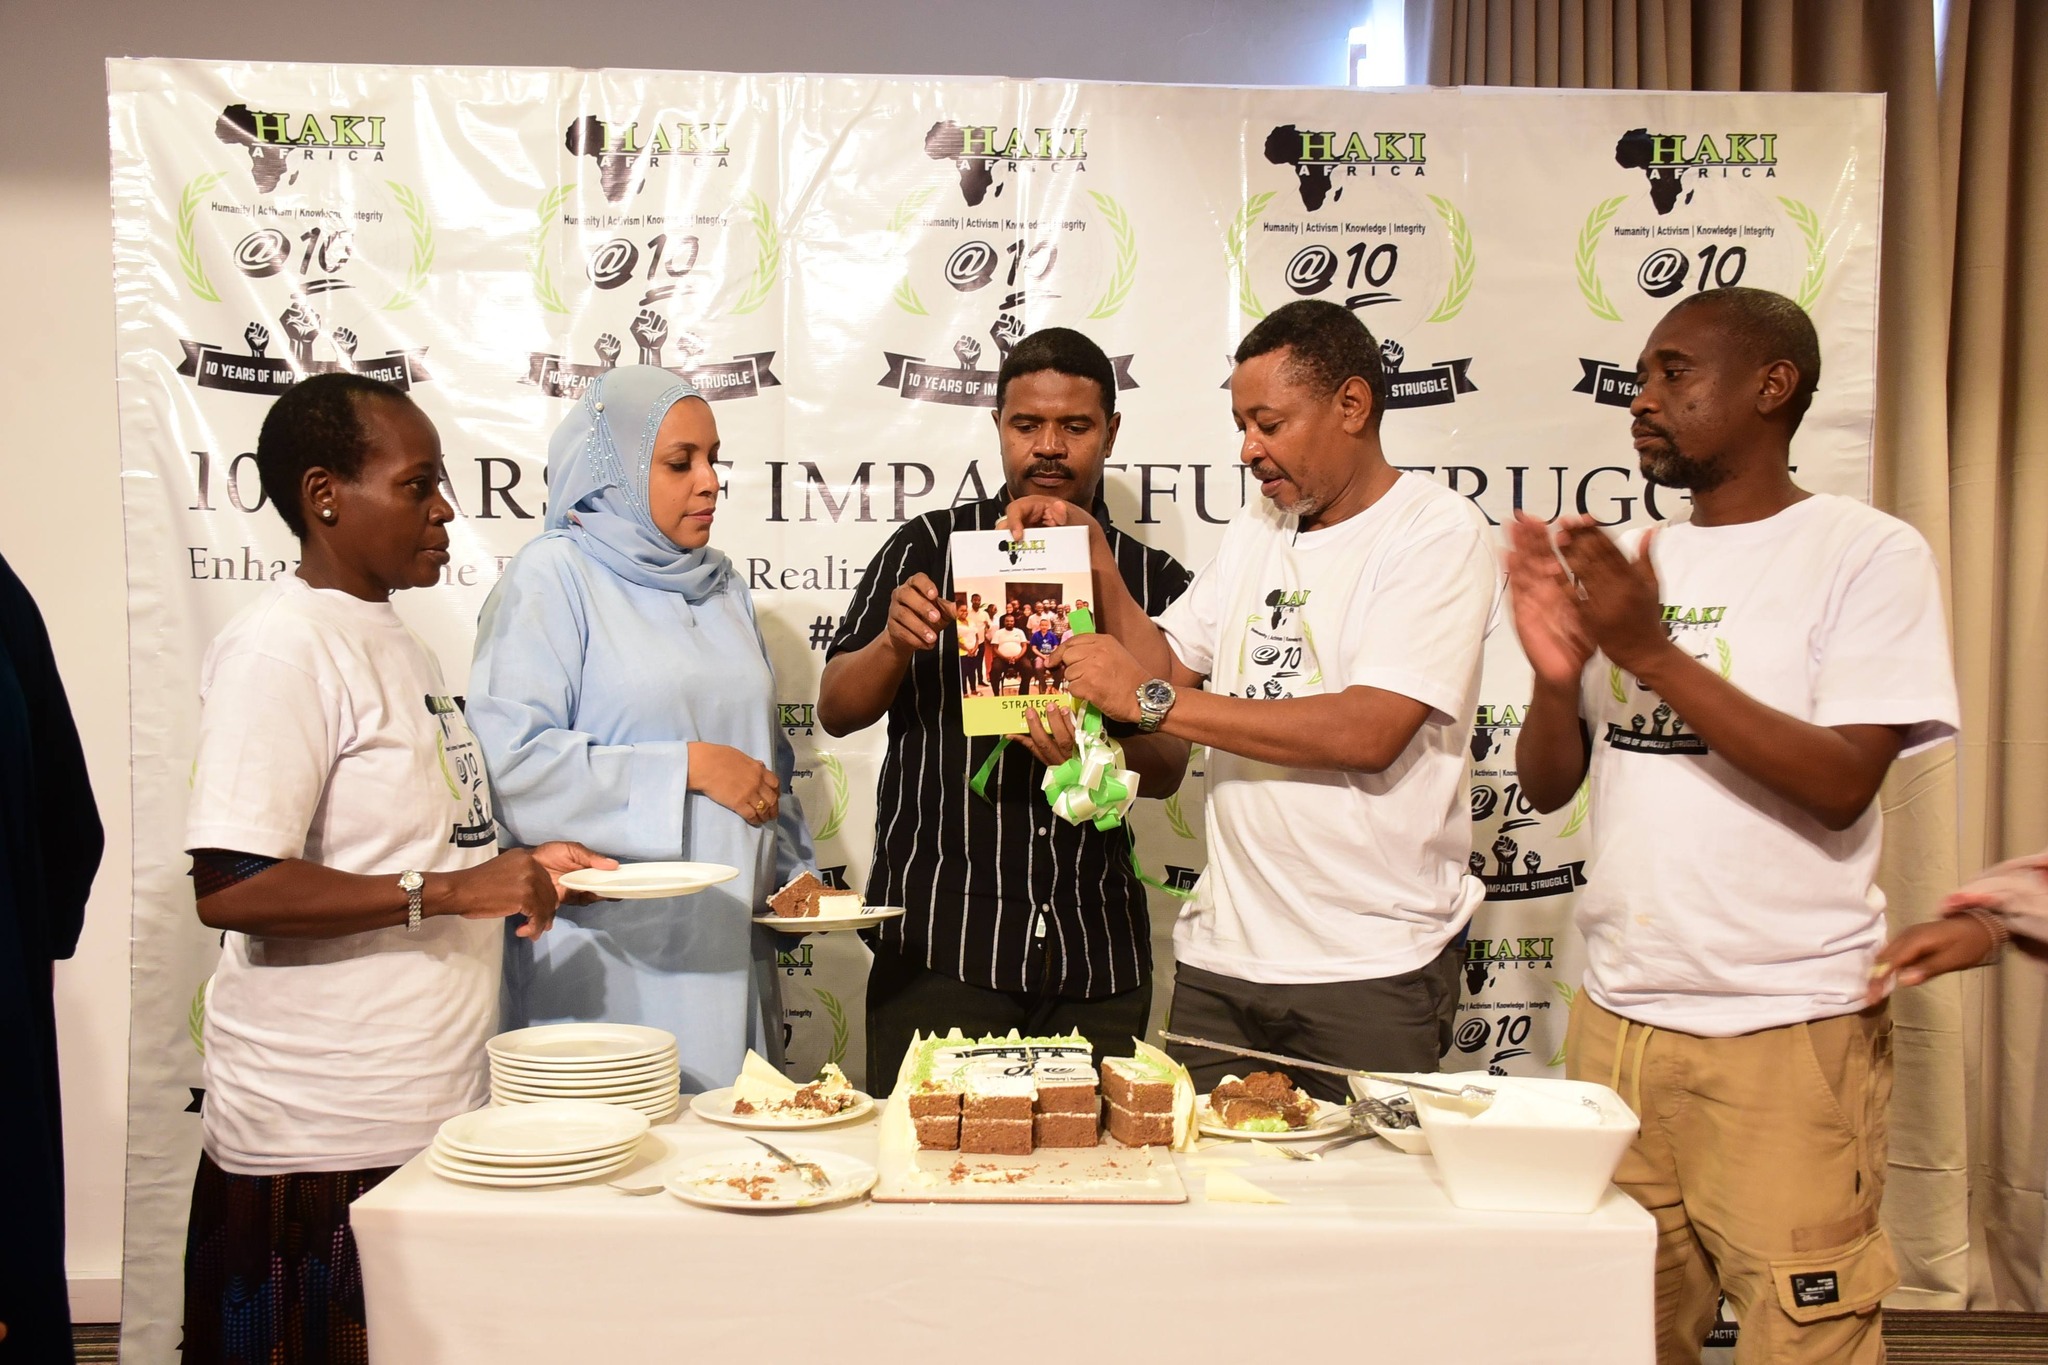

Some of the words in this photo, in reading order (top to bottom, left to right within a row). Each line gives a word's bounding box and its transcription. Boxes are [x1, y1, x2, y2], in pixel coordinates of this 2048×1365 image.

[251, 112, 386, 147] HAKI
[600, 121, 730, 153] HAKI
[959, 126, 1088, 158] HAKI
[1299, 132, 1426, 162] HAKI
[1649, 133, 1778, 164] HAKI
[251, 147, 384, 162] AFRICA
[600, 156, 728, 168] AFRCA
[1299, 165, 1425, 177] AFRICA
[1649, 167, 1776, 179] AFRICA
[354, 212, 383, 223] ntegrity
[966, 218, 999, 230] Activism
[1263, 222, 1299, 235] Humanity
[1306, 222, 1339, 234] Activism
[1345, 222, 1387, 235] Knowledge
[1393, 222, 1426, 236] Integrity
[1614, 225, 1650, 238] Humanity
[1656, 225, 1690, 237] Activism
[1696, 225, 1738, 237] Knowledge
[1744, 225, 1775, 238] Integrity
[205, 361, 219, 376] 10
[221, 364, 256, 382] YEARS
[258, 369, 270, 384] OF
[691, 371, 752, 390] STRUGGLE
[908, 372, 921, 388] 10
[924, 375, 962, 393] YEARS
[966, 380, 981, 395] OF
[1391, 378, 1449, 398] STRUGGLE
[1602, 377, 1616, 393] 10
[189, 451, 267, 513] 10
[1661, 605, 1727, 624] HAKI
[1002, 699, 1060, 710] STRATEGC
[792, 769, 813, 778] ntegrity
[1474, 769, 1498, 777] Activism
[1486, 879, 1529, 894] IMPACTFUL
[1531, 874, 1569, 890] STRUGGLE
[1467, 938, 1554, 960] HAKI
[1466, 961, 1552, 971] AFRICA
[1469, 1002, 1492, 1010] Activism
[1496, 1002, 1525, 1011] Knowledge
